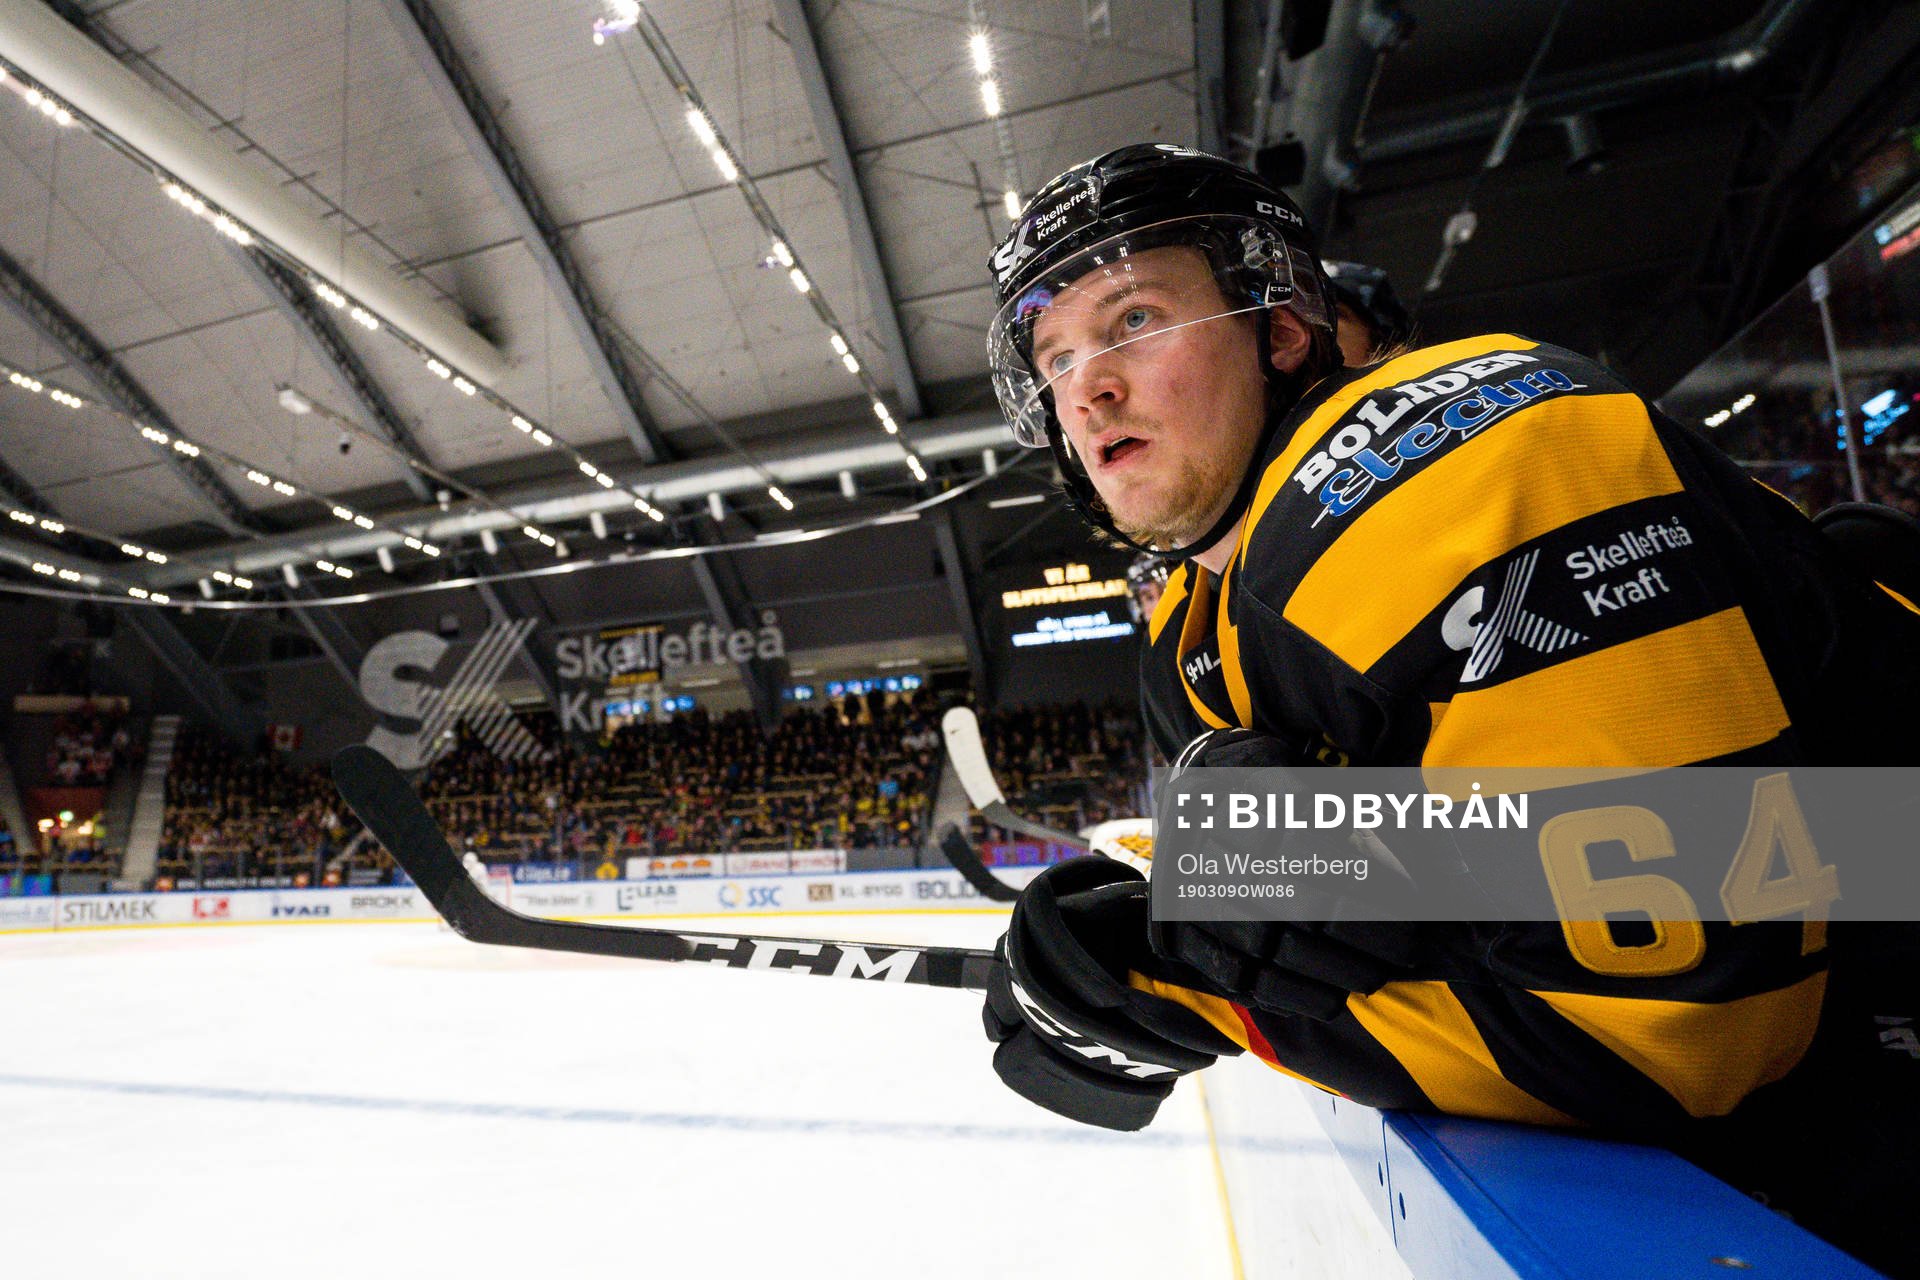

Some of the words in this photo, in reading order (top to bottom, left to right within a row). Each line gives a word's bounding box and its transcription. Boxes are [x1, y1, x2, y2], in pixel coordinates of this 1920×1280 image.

[1036, 214, 1068, 242] Kraft
[1255, 200, 1304, 228] CCM
[1293, 351, 1541, 495] BOLIDEN
[1565, 514, 1694, 581] Skellefteå
[1581, 567, 1671, 617] Kraft
[555, 610, 786, 680] Skellefteå
[748, 885, 783, 907] SSC
[1537, 771, 1844, 978] 64
[63, 900, 157, 923] STILMEK
[684, 936, 922, 984] CCM
